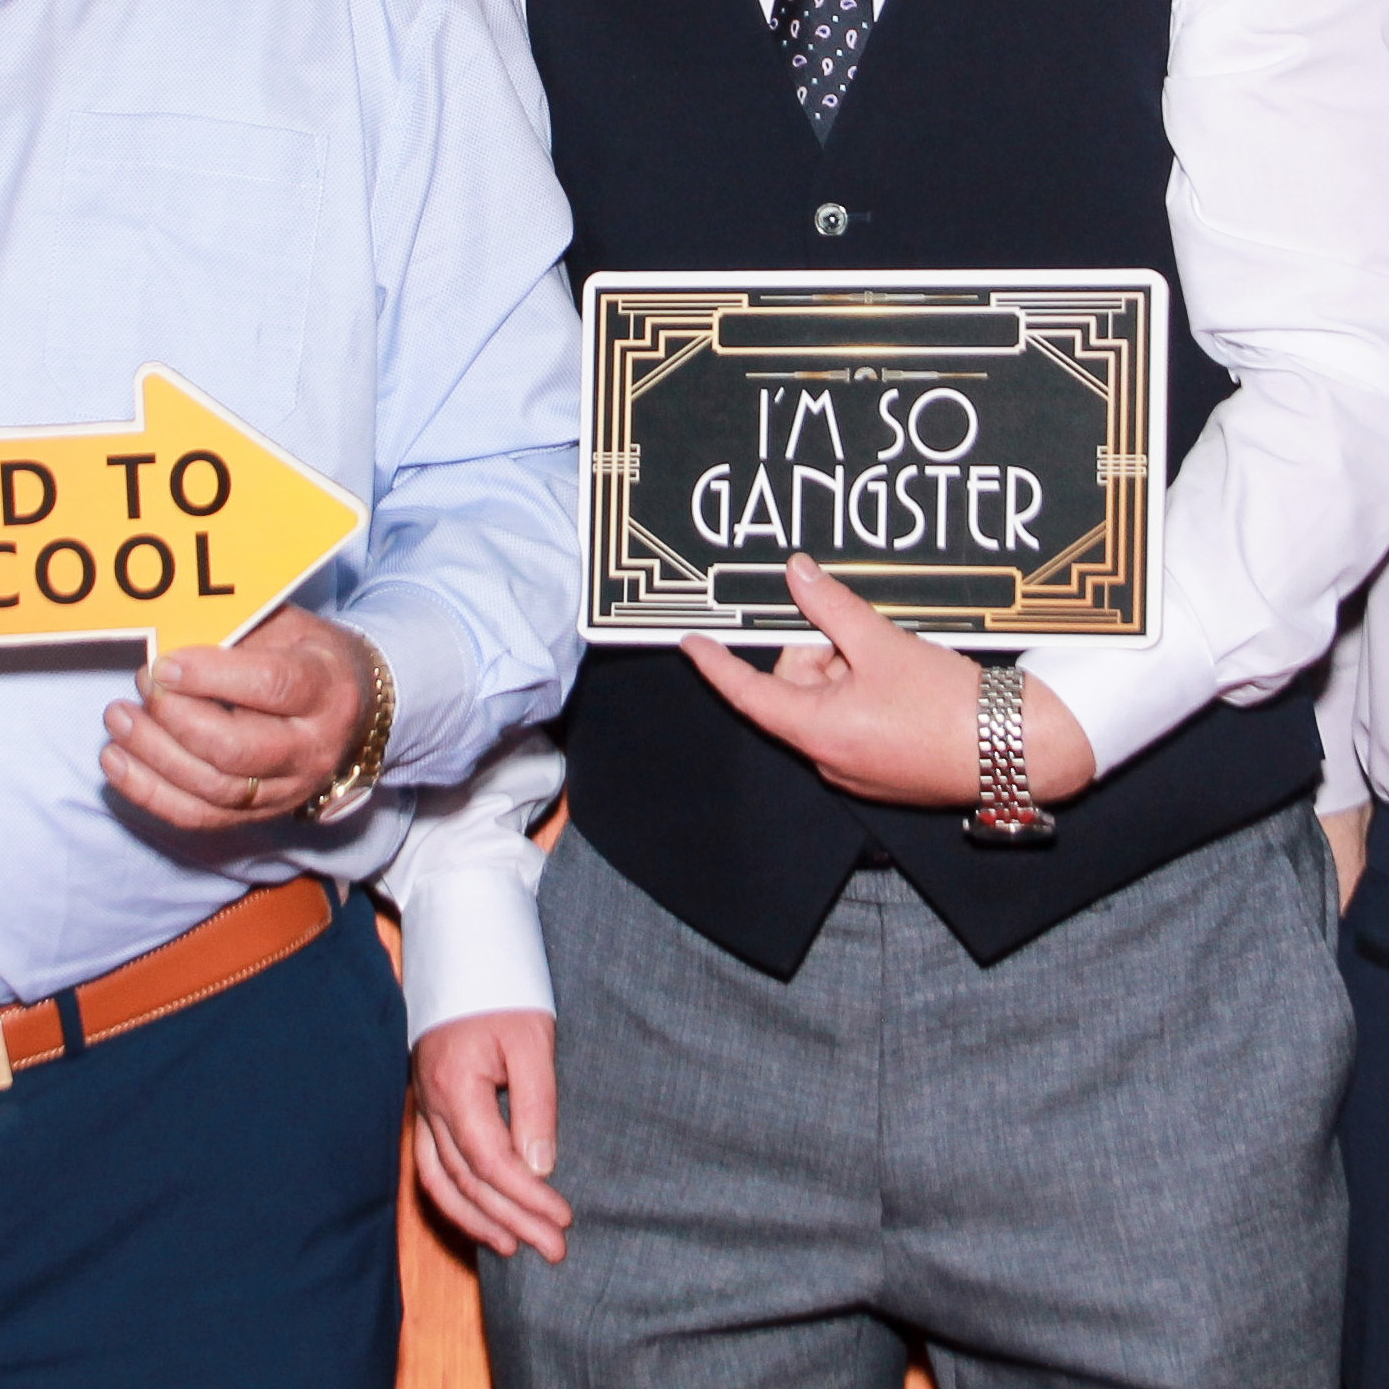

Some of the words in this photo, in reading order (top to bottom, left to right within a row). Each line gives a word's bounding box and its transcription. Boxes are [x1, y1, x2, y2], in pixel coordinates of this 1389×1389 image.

[758, 387, 845, 461] I'M
[877, 387, 979, 462] SO
[106, 448, 233, 520] TO
[690, 461, 1044, 551] GANGSTER
